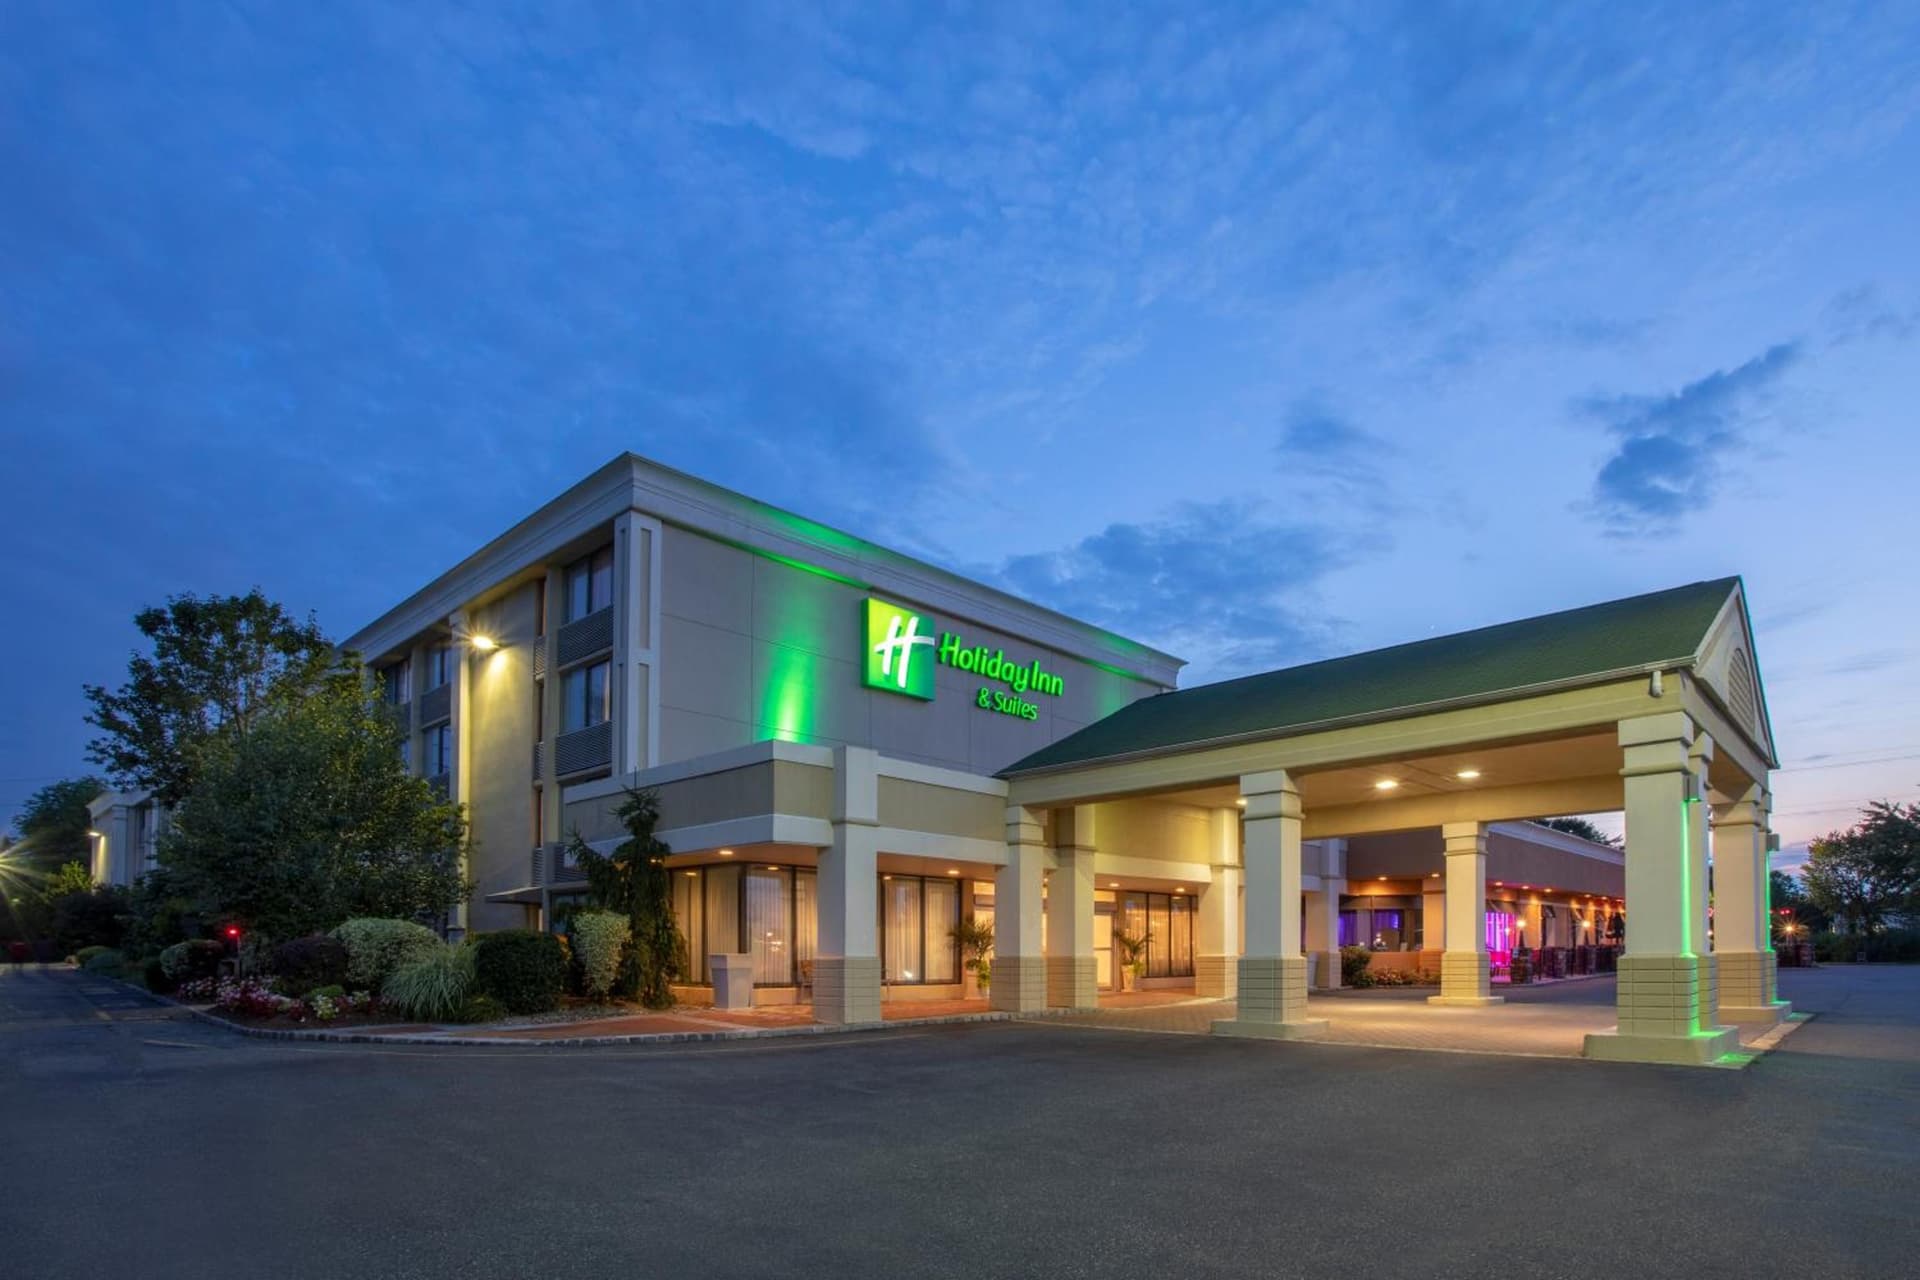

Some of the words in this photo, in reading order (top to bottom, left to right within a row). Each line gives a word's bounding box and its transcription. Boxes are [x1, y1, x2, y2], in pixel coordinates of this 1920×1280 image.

[874, 615, 935, 689] H
[939, 632, 1028, 692] Holiday
[1031, 660, 1064, 696] Inn
[978, 687, 991, 708] &
[992, 691, 1038, 720] Suites
